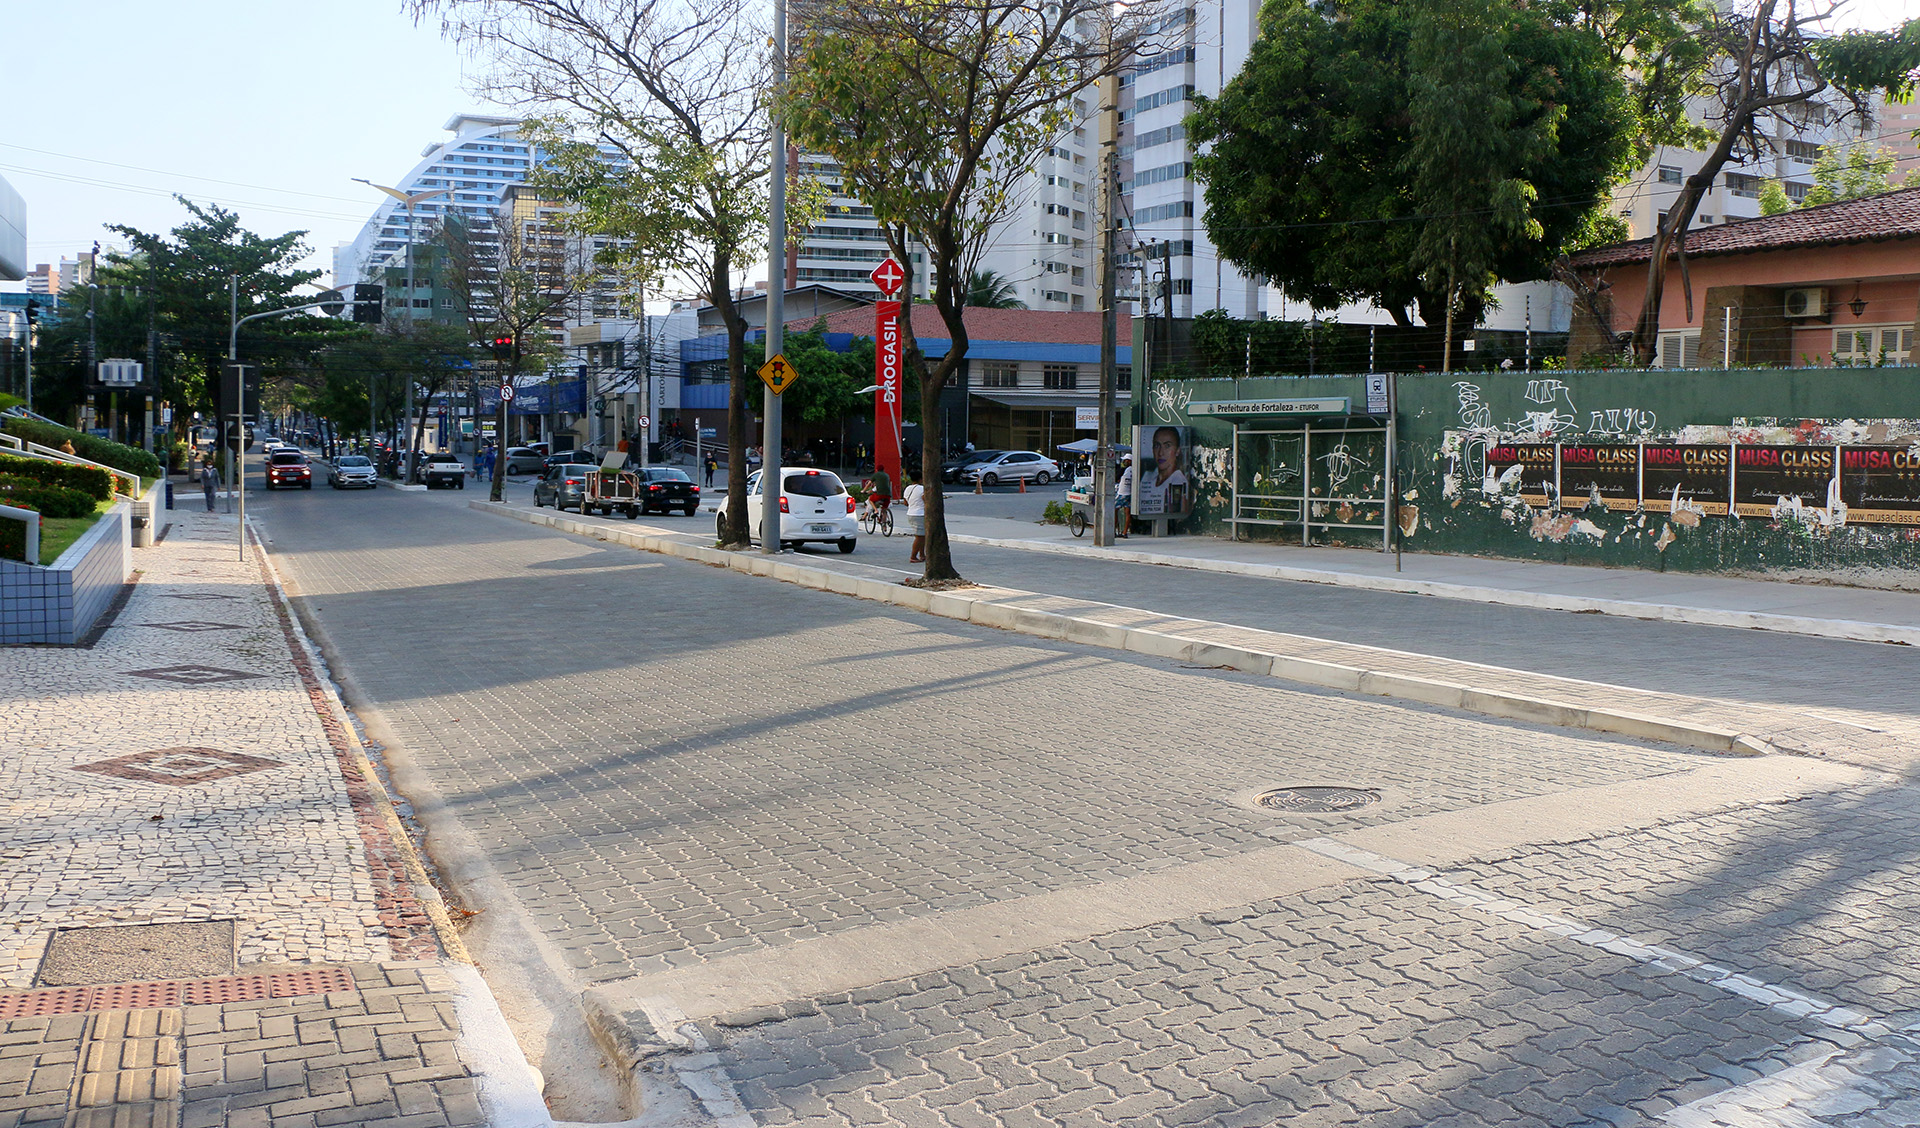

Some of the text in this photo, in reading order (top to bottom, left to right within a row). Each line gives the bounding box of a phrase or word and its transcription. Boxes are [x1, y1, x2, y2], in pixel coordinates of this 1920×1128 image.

[883, 315, 897, 403] DROGASIL
[1217, 404, 1250, 413] Prefeitura
[1251, 403, 1260, 412] de
[1261, 402, 1294, 412] Fortaleza
[1299, 403, 1320, 411] ETUFOR
[1487, 447, 1554, 463] MUSA CLASS
[1563, 447, 1637, 465] MUSA CLASS
[1646, 448, 1728, 466] MUSA CLASS
[1738, 449, 1832, 468] MUSA CLASS
[1844, 450, 1892, 469] MUSA
